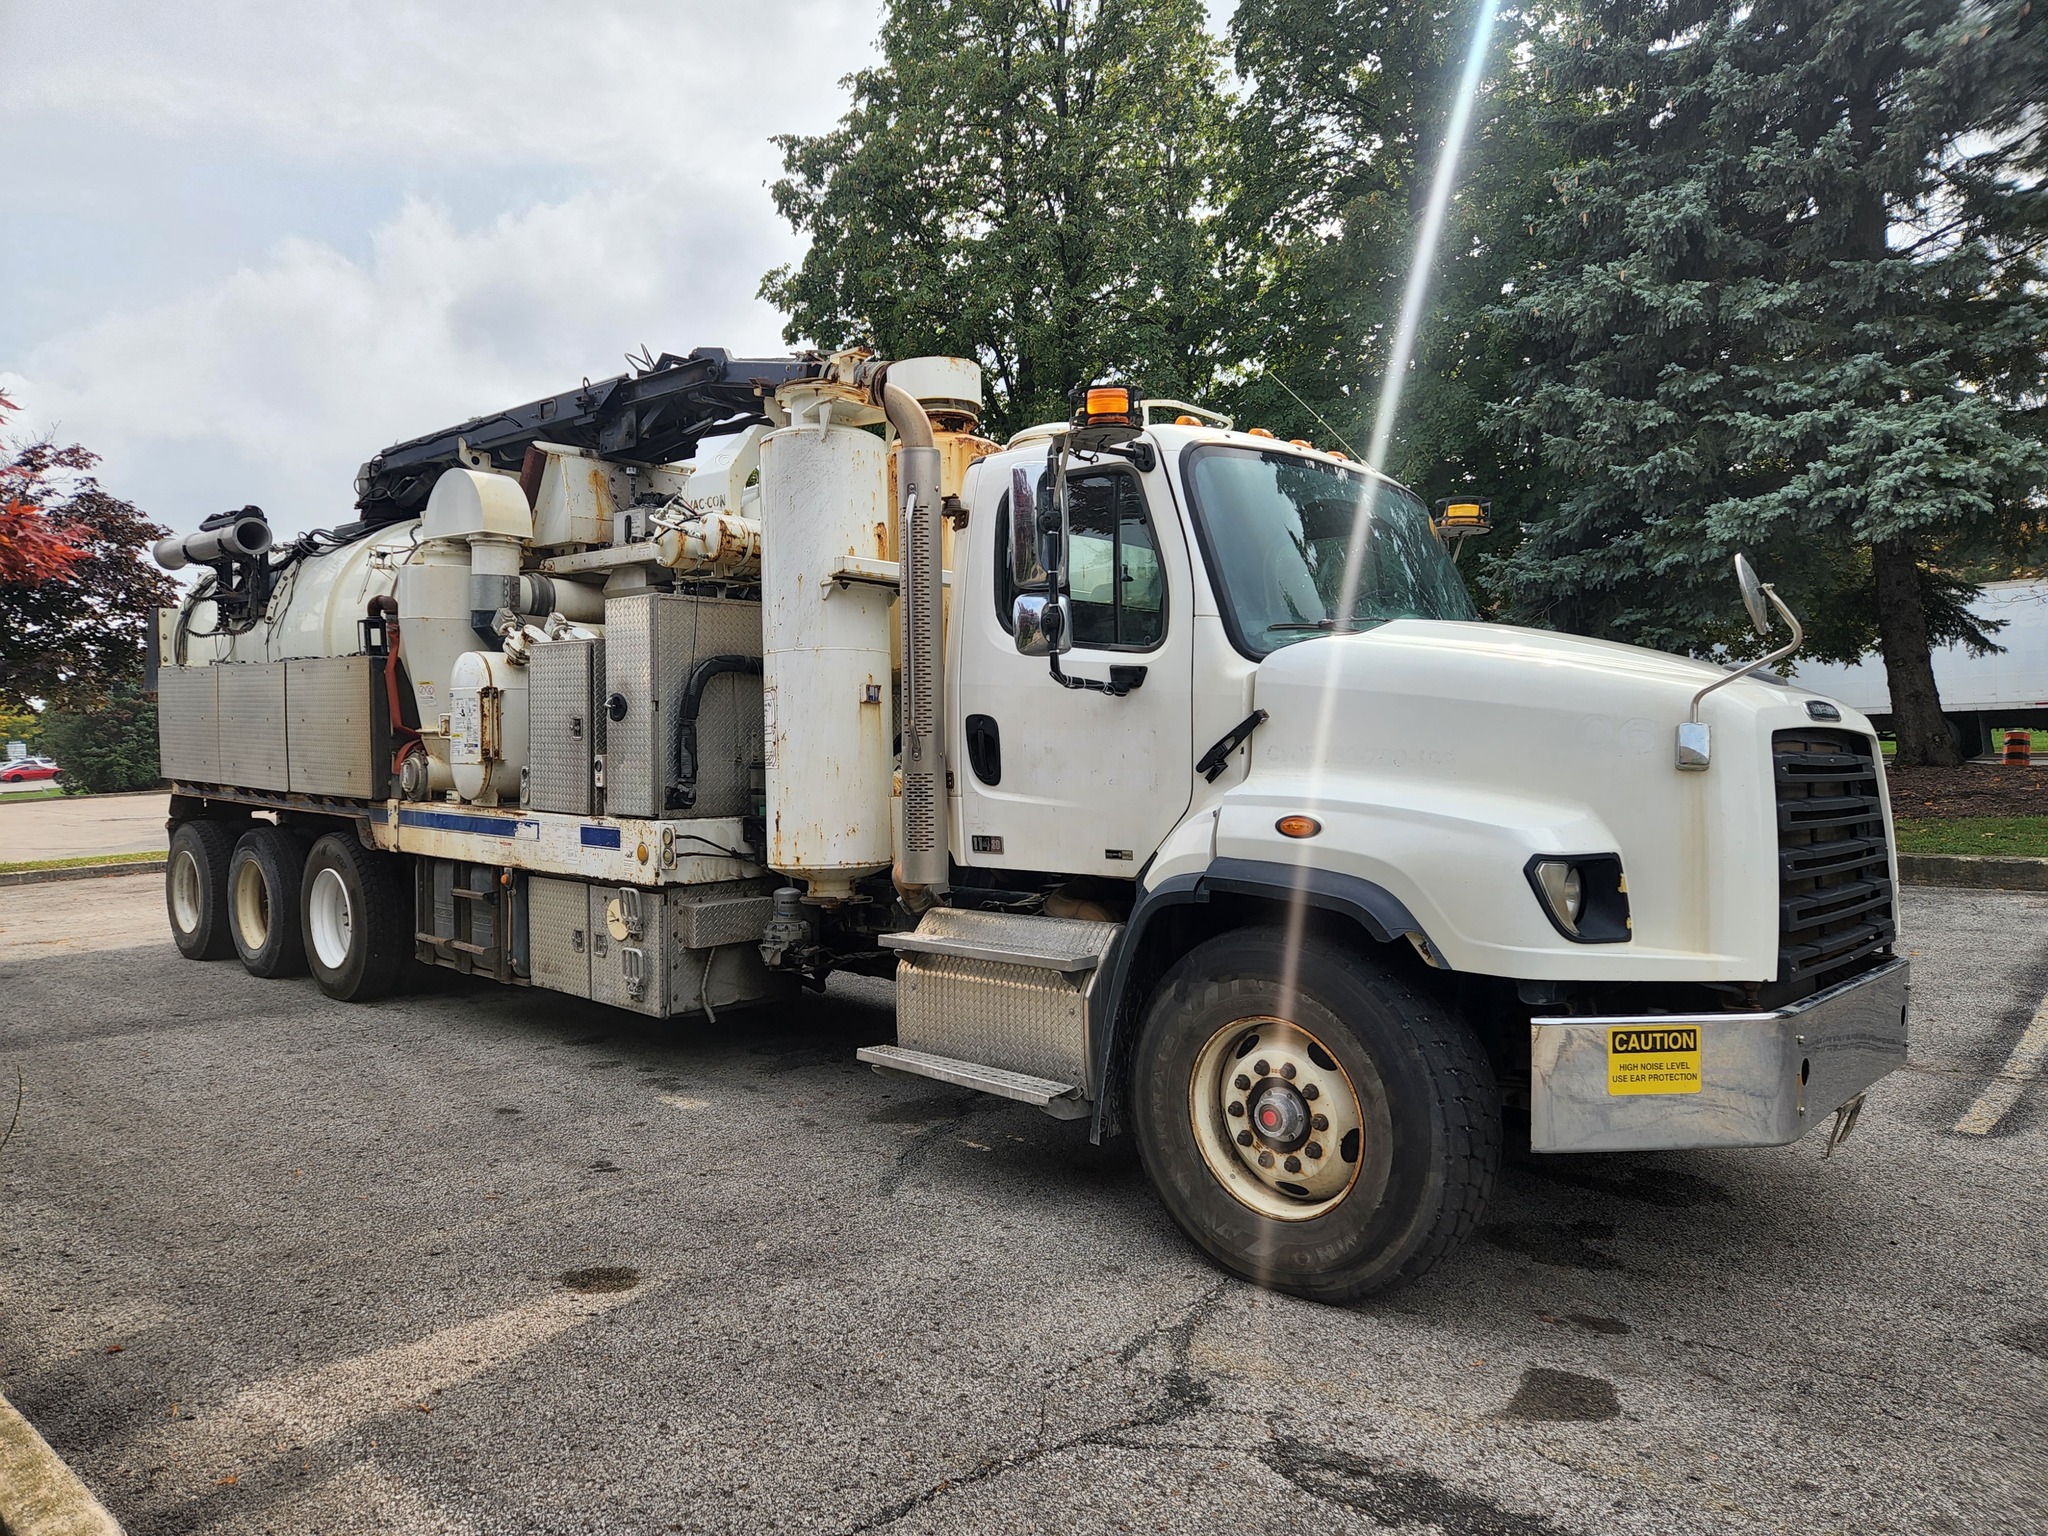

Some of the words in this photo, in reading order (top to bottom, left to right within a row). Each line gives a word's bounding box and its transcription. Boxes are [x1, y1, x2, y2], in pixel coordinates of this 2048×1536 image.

[1614, 1032, 1695, 1051] CAUTION
[1619, 1063, 1638, 1071] HIGH
[1640, 1062, 1664, 1070] NOISE
[1666, 1062, 1690, 1070] LEVEL
[1612, 1075, 1628, 1083] USE
[1630, 1074, 1646, 1082] EAR
[1648, 1073, 1698, 1082] PROTECTION
